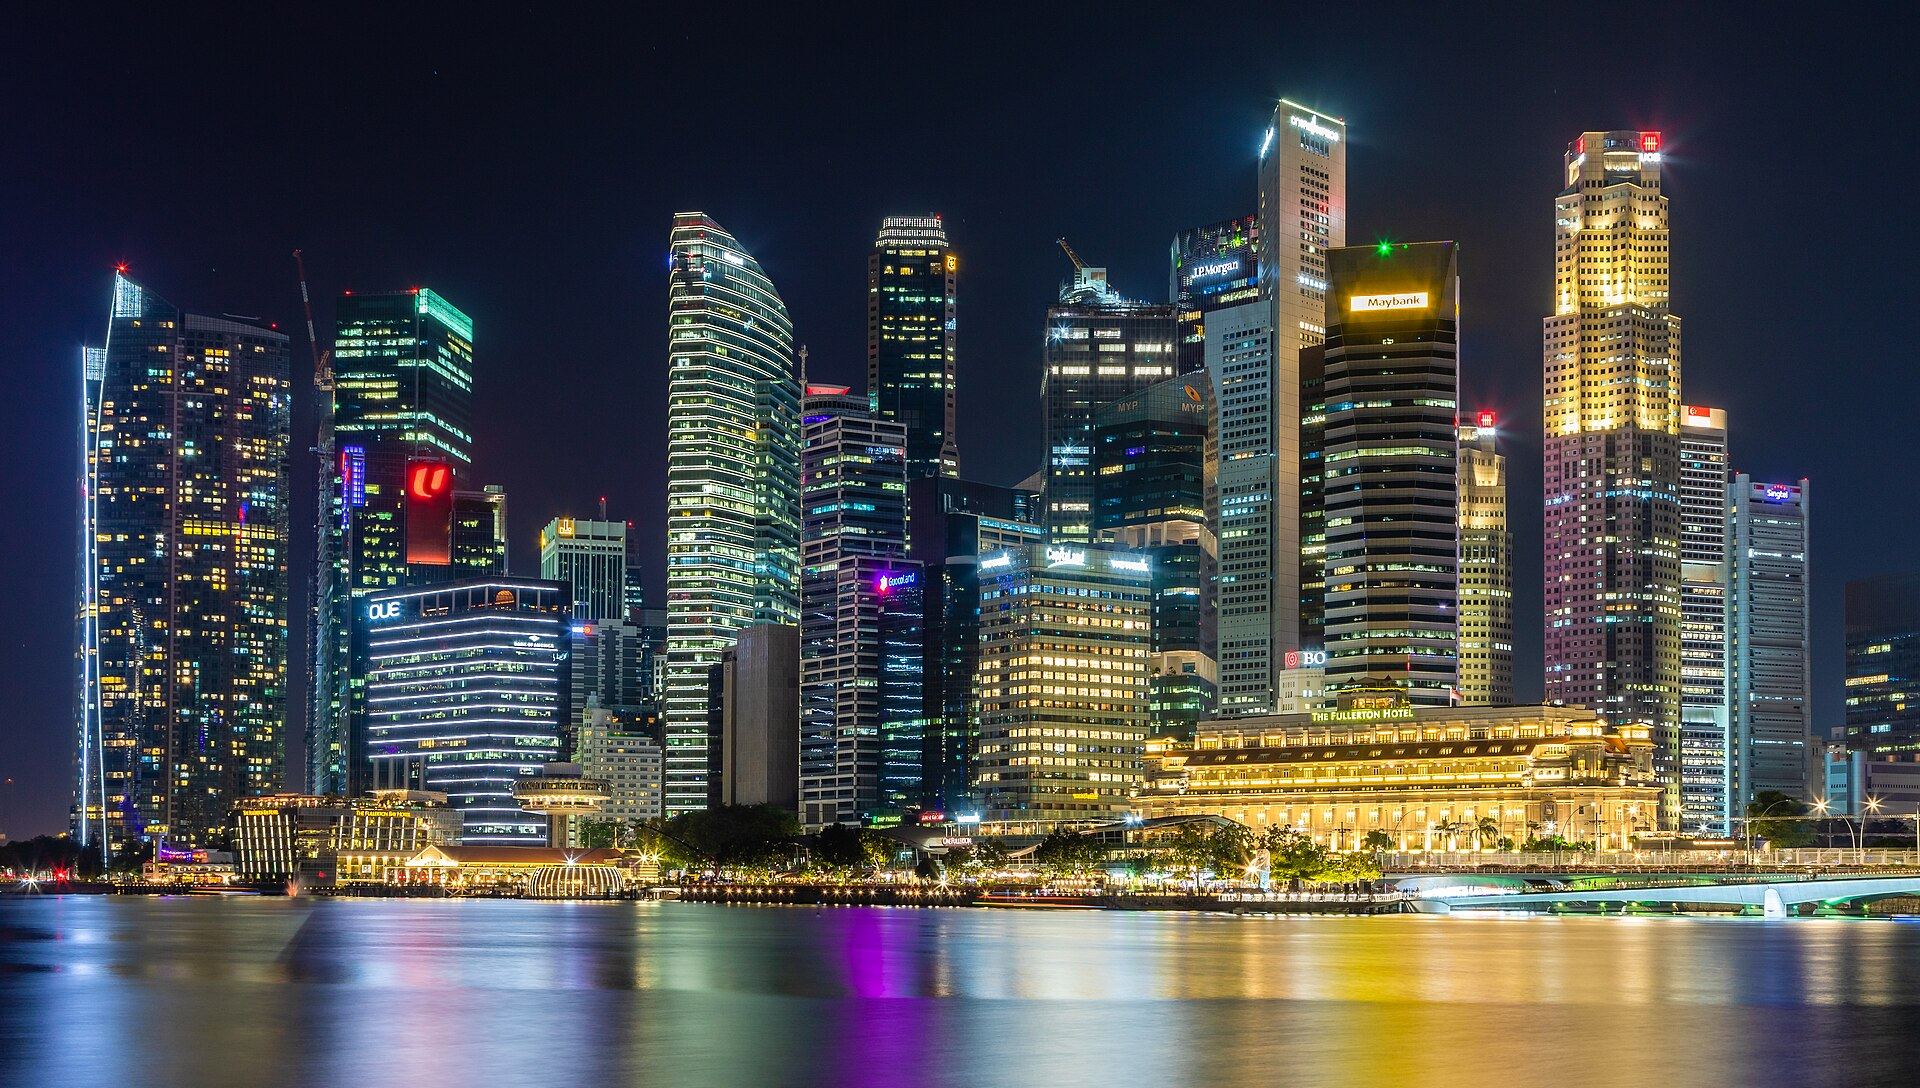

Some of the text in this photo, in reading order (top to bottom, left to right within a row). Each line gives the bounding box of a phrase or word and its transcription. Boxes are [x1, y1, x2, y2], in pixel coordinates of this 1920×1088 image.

[1367, 295, 1420, 308] Maybank
[369, 601, 400, 620] OUE
[1312, 708, 1414, 721] THE FULLERTON HOTEL
